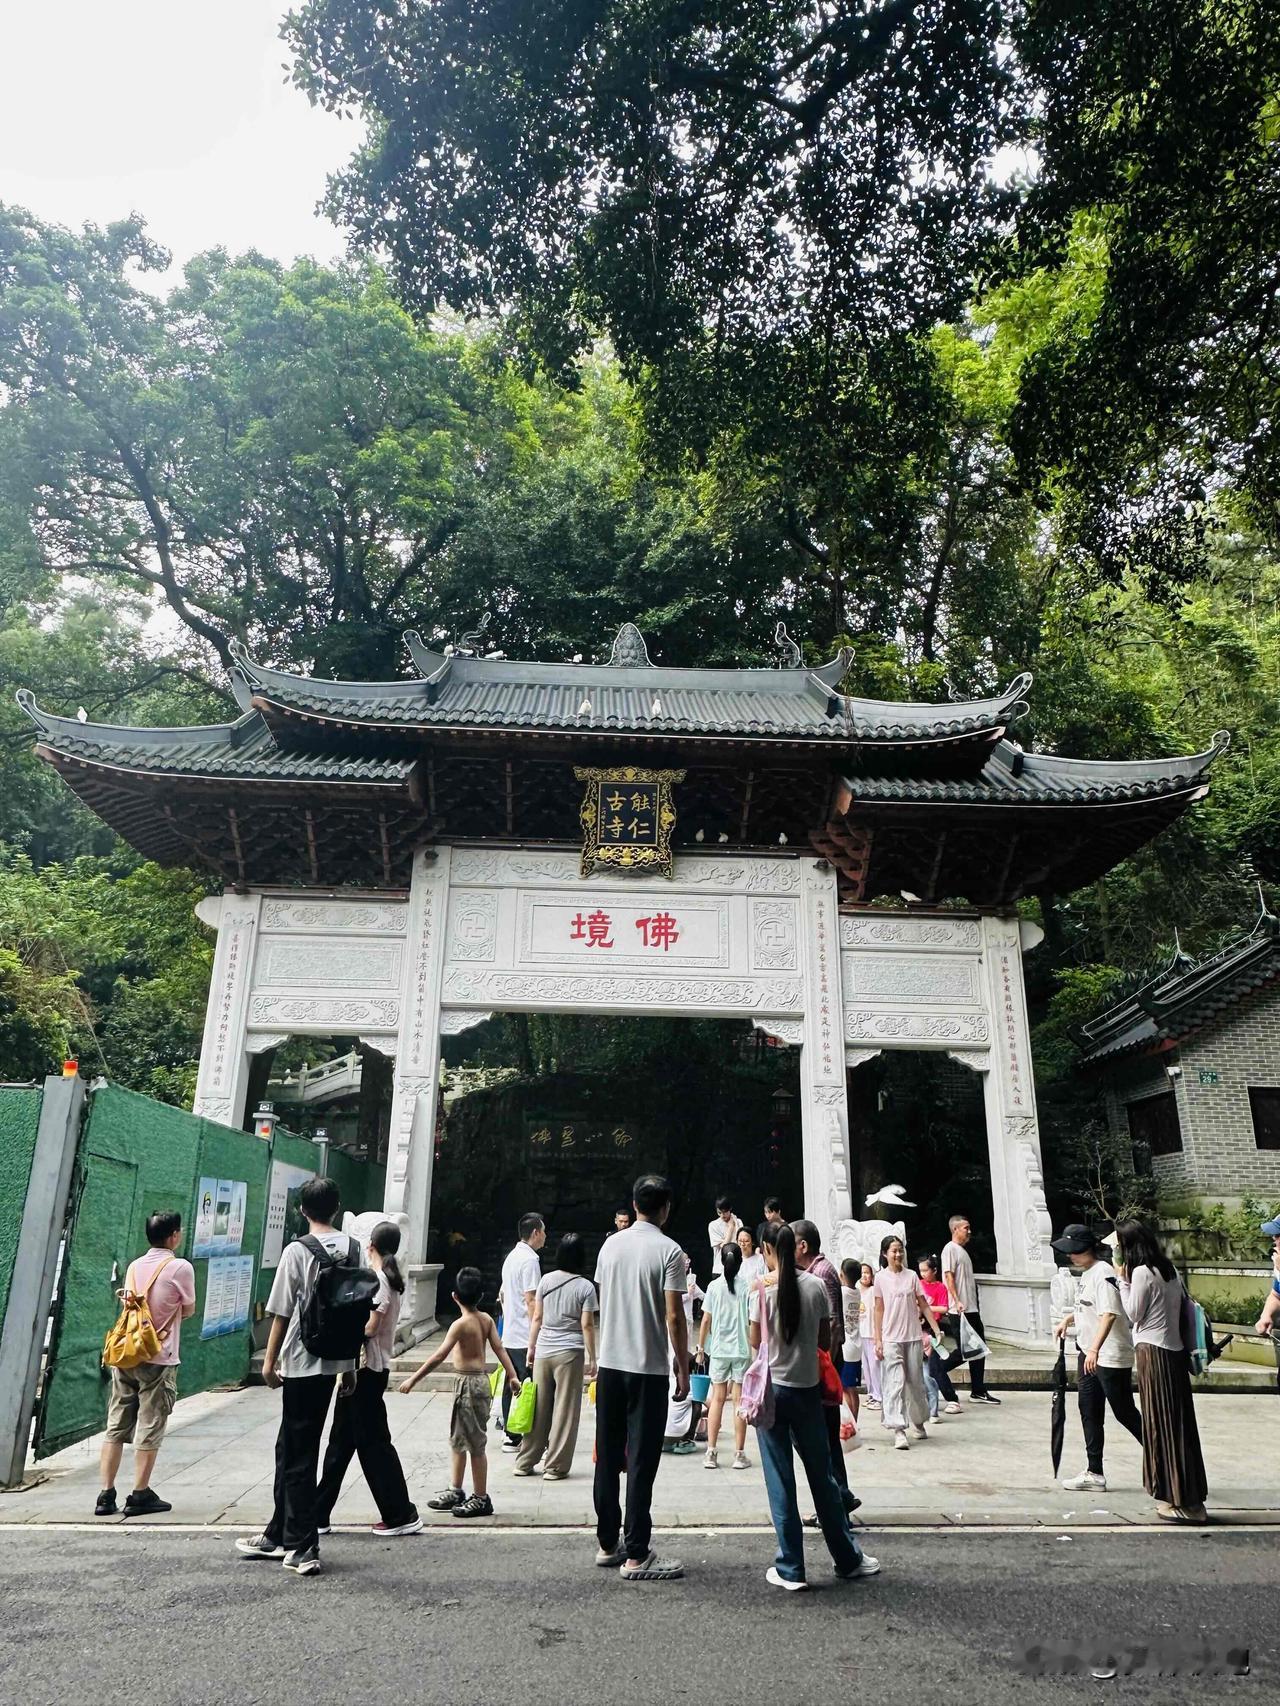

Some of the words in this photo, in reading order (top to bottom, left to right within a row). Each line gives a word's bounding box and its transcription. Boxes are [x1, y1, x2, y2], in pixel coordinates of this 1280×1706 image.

[605, 790, 627, 838] 古寺
[627, 791, 651, 839] 能仁
[570, 910, 680, 951] 佛境
